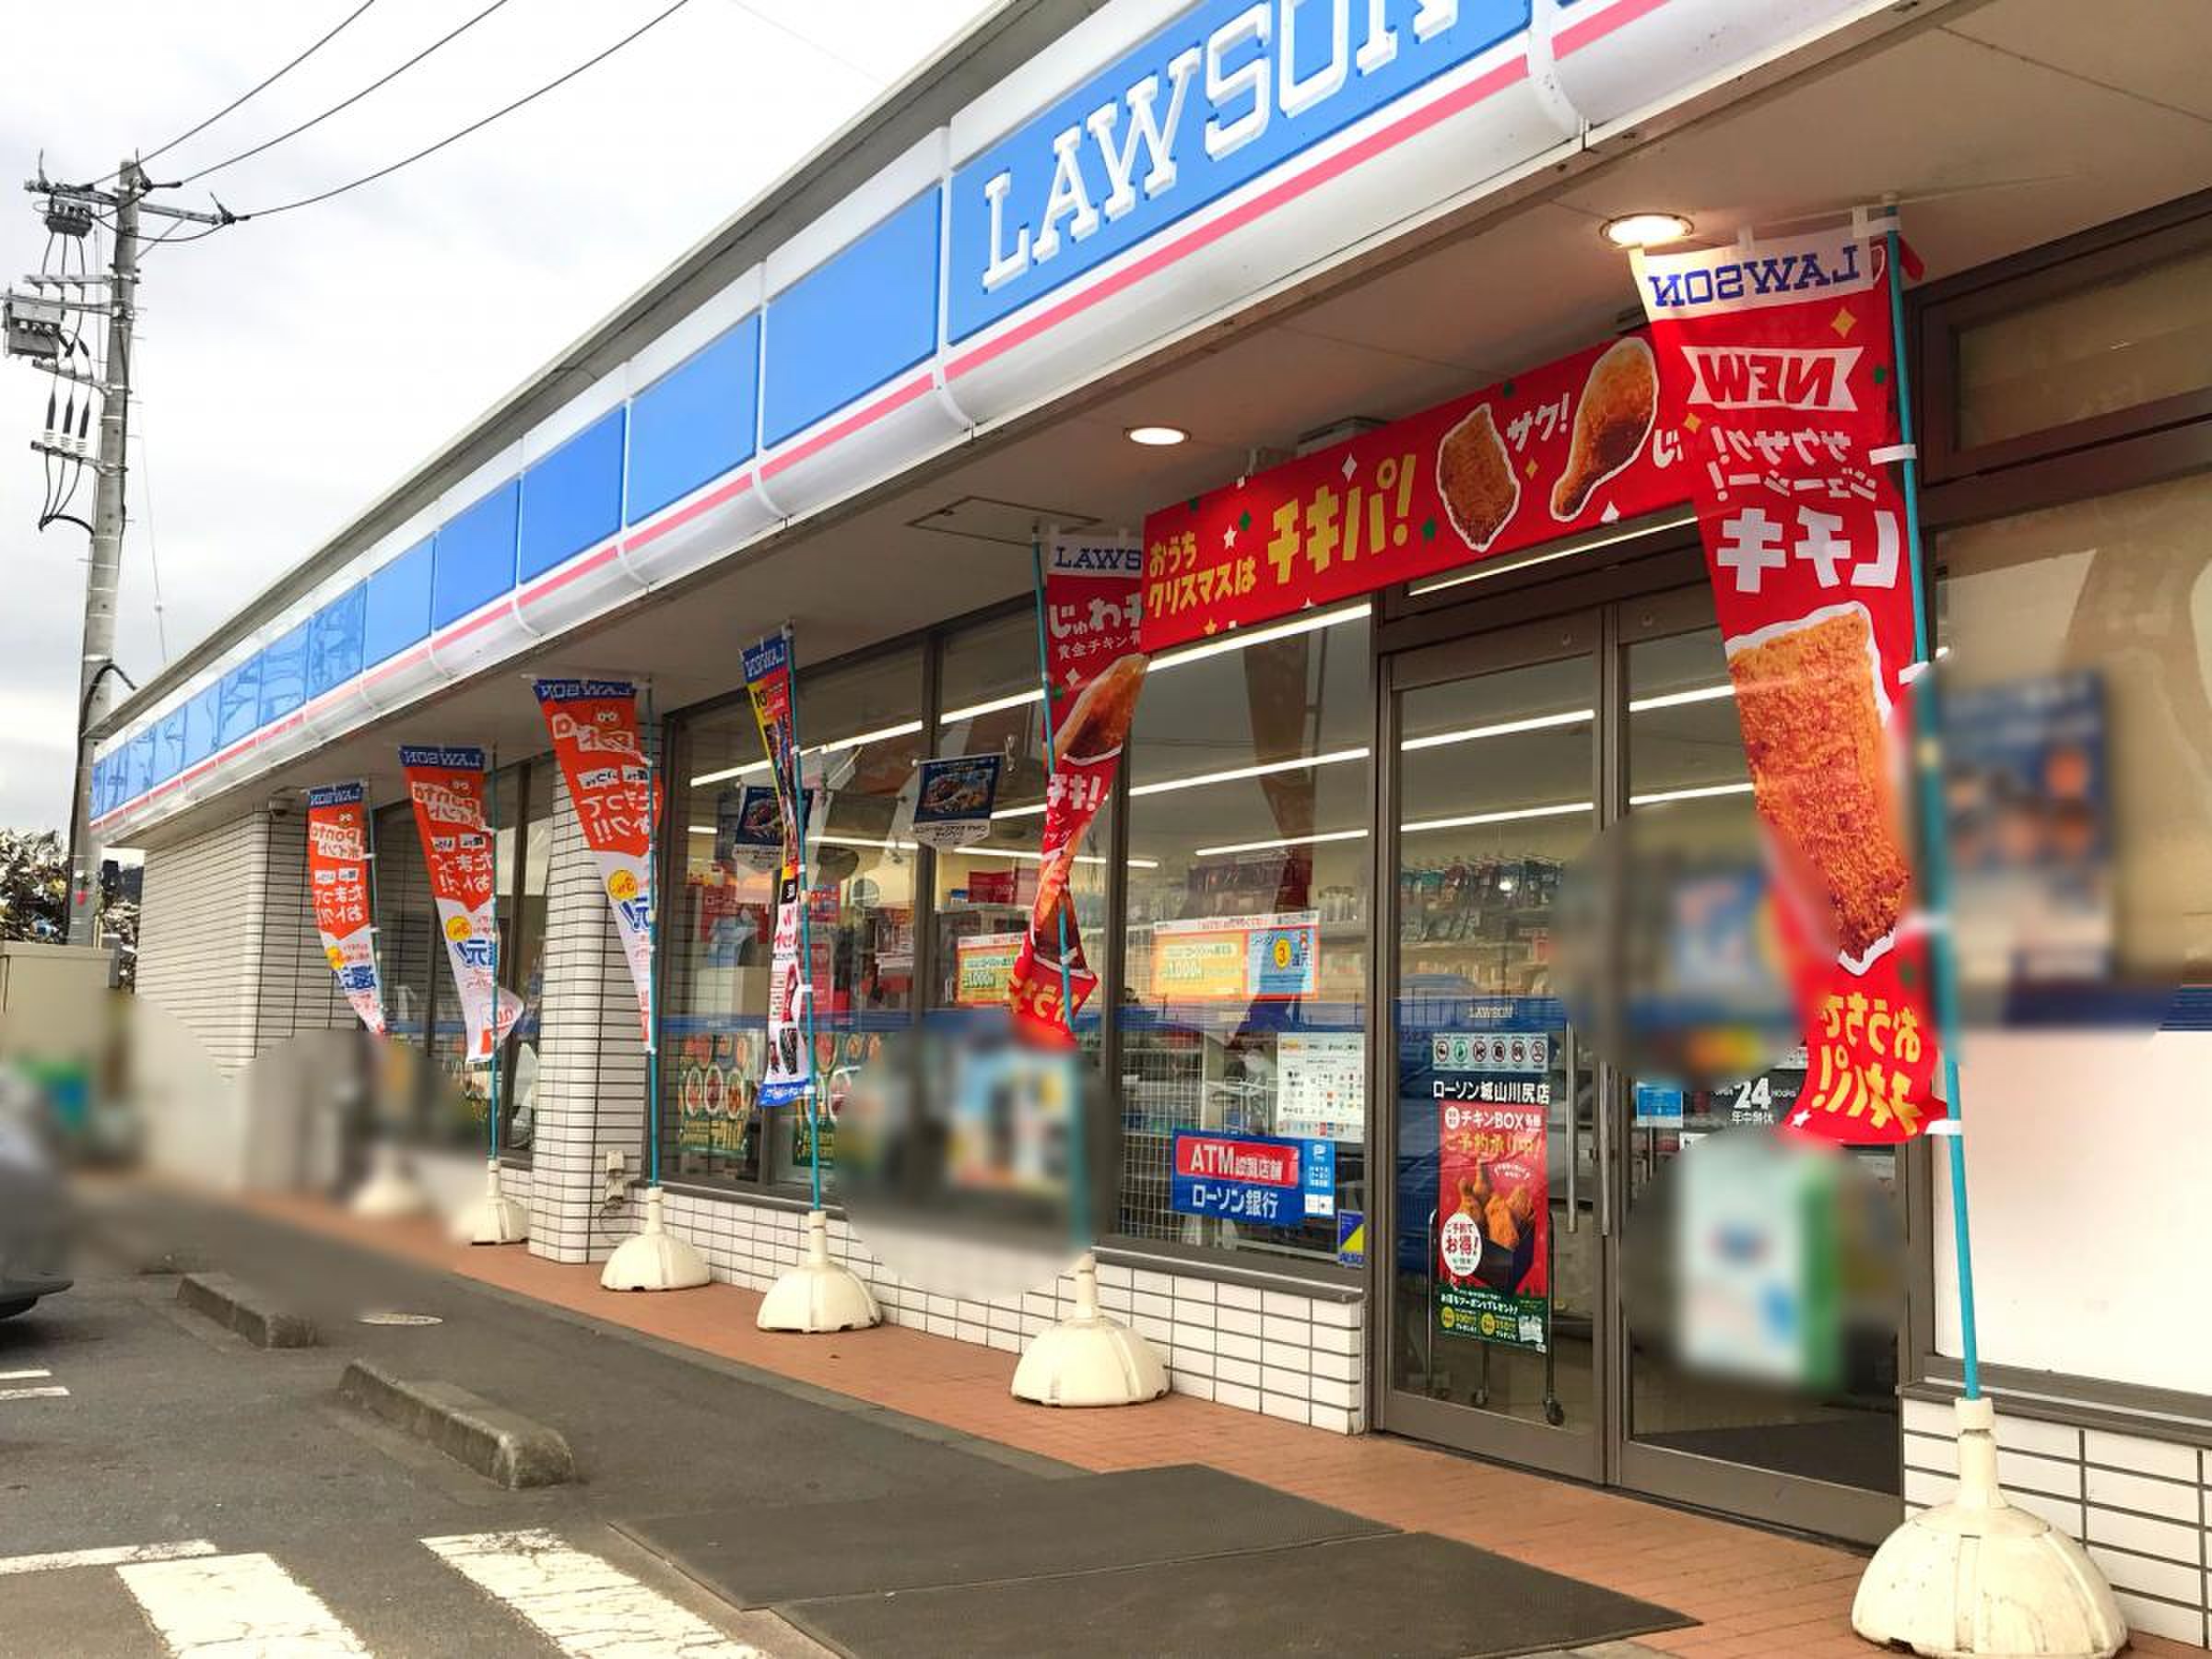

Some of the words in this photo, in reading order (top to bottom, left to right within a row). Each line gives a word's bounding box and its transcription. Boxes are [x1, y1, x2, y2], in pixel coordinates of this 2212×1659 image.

[1267, 454, 1417, 584] チキパ!
[1148, 529, 1197, 579] おうち
[1147, 557, 1257, 618] クリスマスは
[1432, 1079, 1550, 1105] ローソン城山川尻店
[1733, 1077, 1772, 1111] 24
[1192, 1183, 1279, 1219] ローソン銀行
